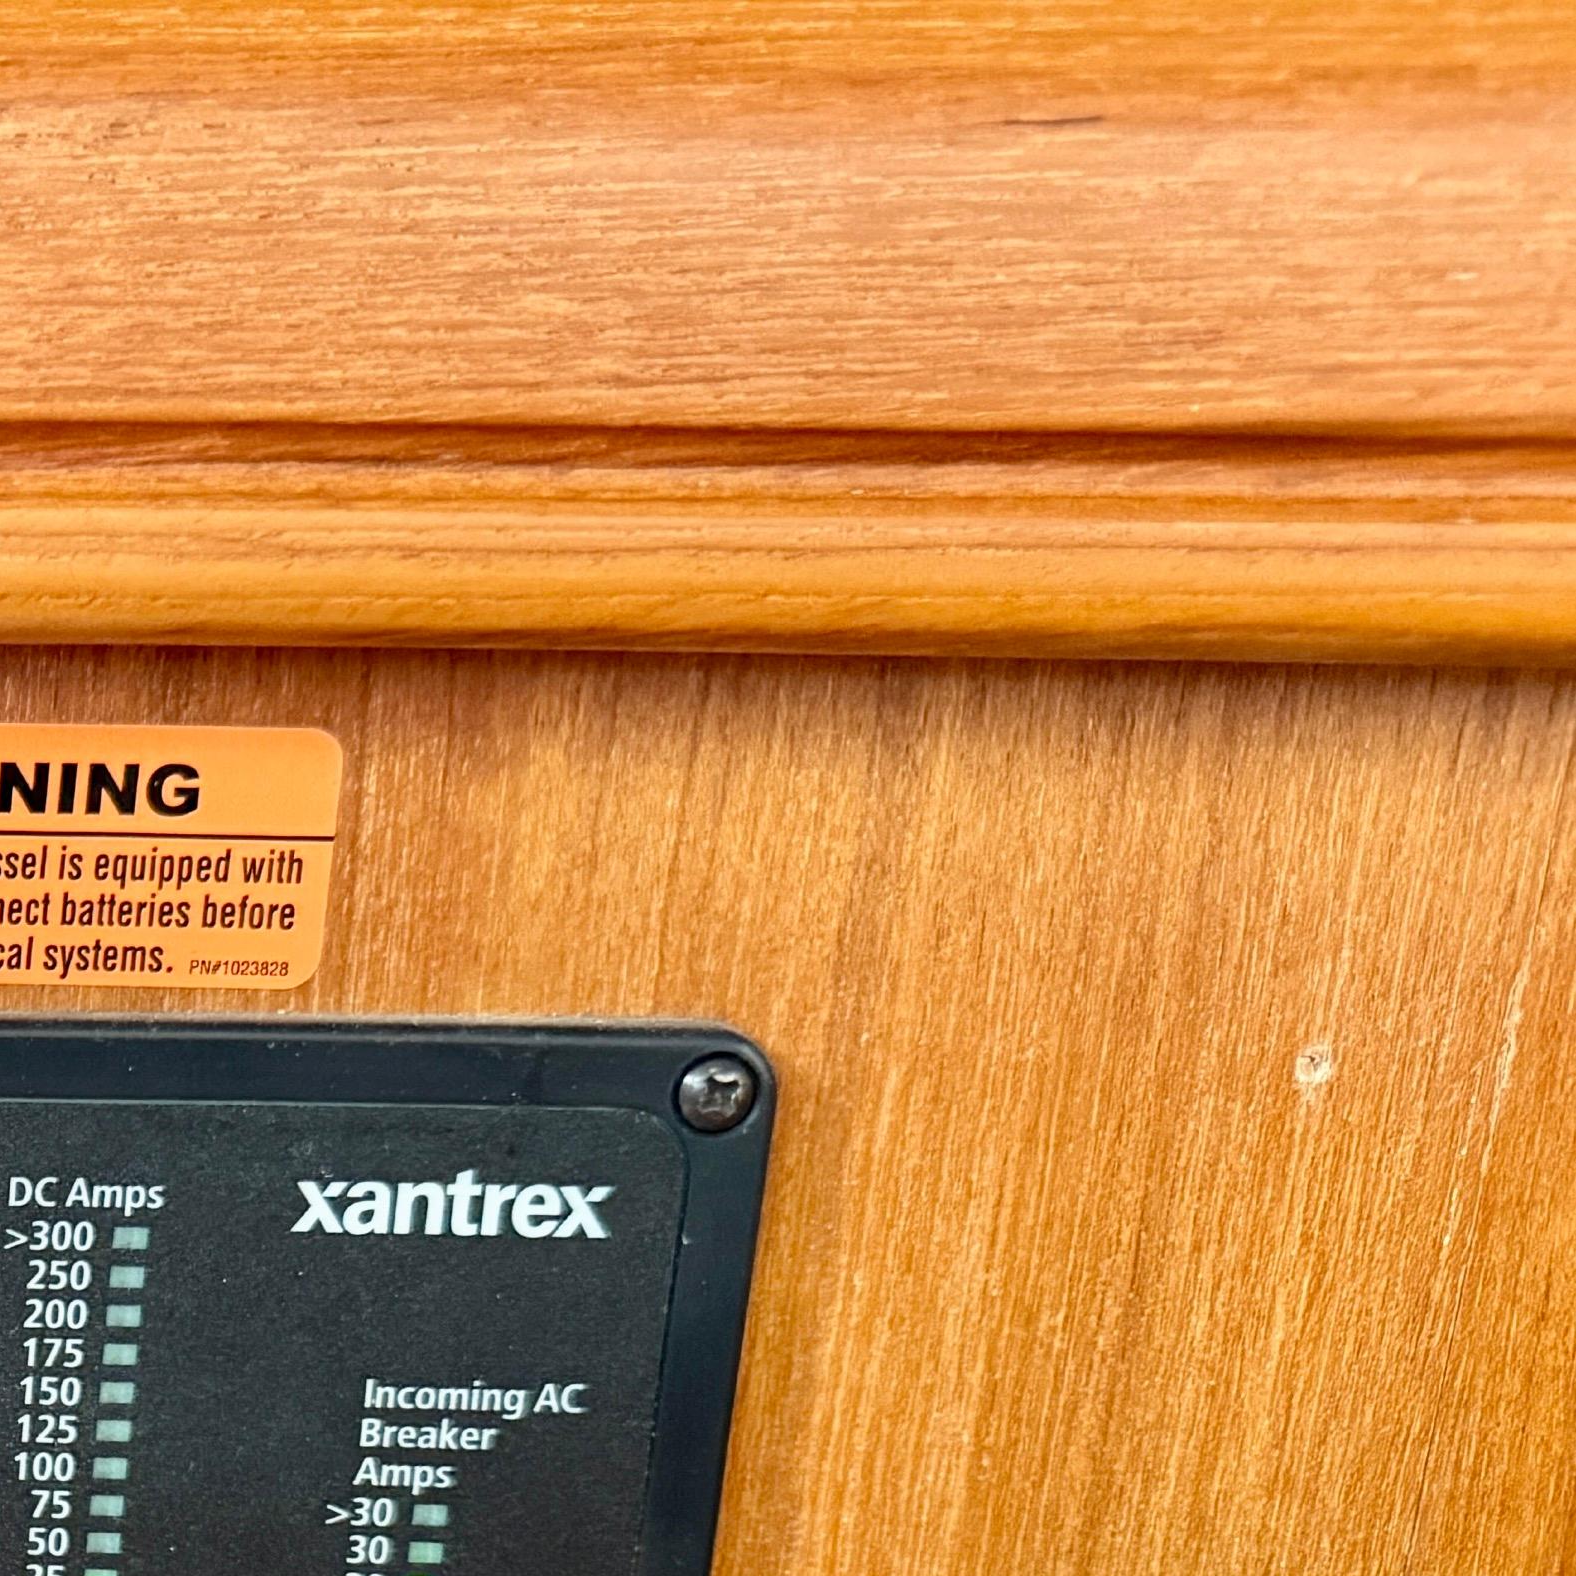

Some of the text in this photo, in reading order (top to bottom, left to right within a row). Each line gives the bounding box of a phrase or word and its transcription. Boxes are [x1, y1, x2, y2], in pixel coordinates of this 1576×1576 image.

[57, 847, 83, 881] is
[93, 849, 230, 890] equipped
[242, 849, 303, 885] with
[61, 894, 190, 929] batteries
[200, 896, 295, 931] before
[43, 942, 173, 977] systems.
[188, 959, 288, 977] PN#1023828
[8, 1177, 166, 1216] DC Amps
[290, 1169, 617, 1239] xantrex
[4, 1221, 95, 1251] >300
[26, 1260, 93, 1290] 250
[23, 1299, 88, 1329] 200
[23, 1338, 85, 1368] 175
[19, 1376, 82, 1406] 150
[364, 1378, 589, 1420] Incoming AC
[17, 1414, 79, 1444] 125
[359, 1419, 499, 1451] Breaker
[14, 1452, 76, 1481] 100
[352, 1458, 457, 1495] Amps
[31, 1490, 72, 1519] 75
[324, 1497, 395, 1527] >30
[27, 1527, 70, 1556] 50
[345, 1535, 392, 1565] 30
